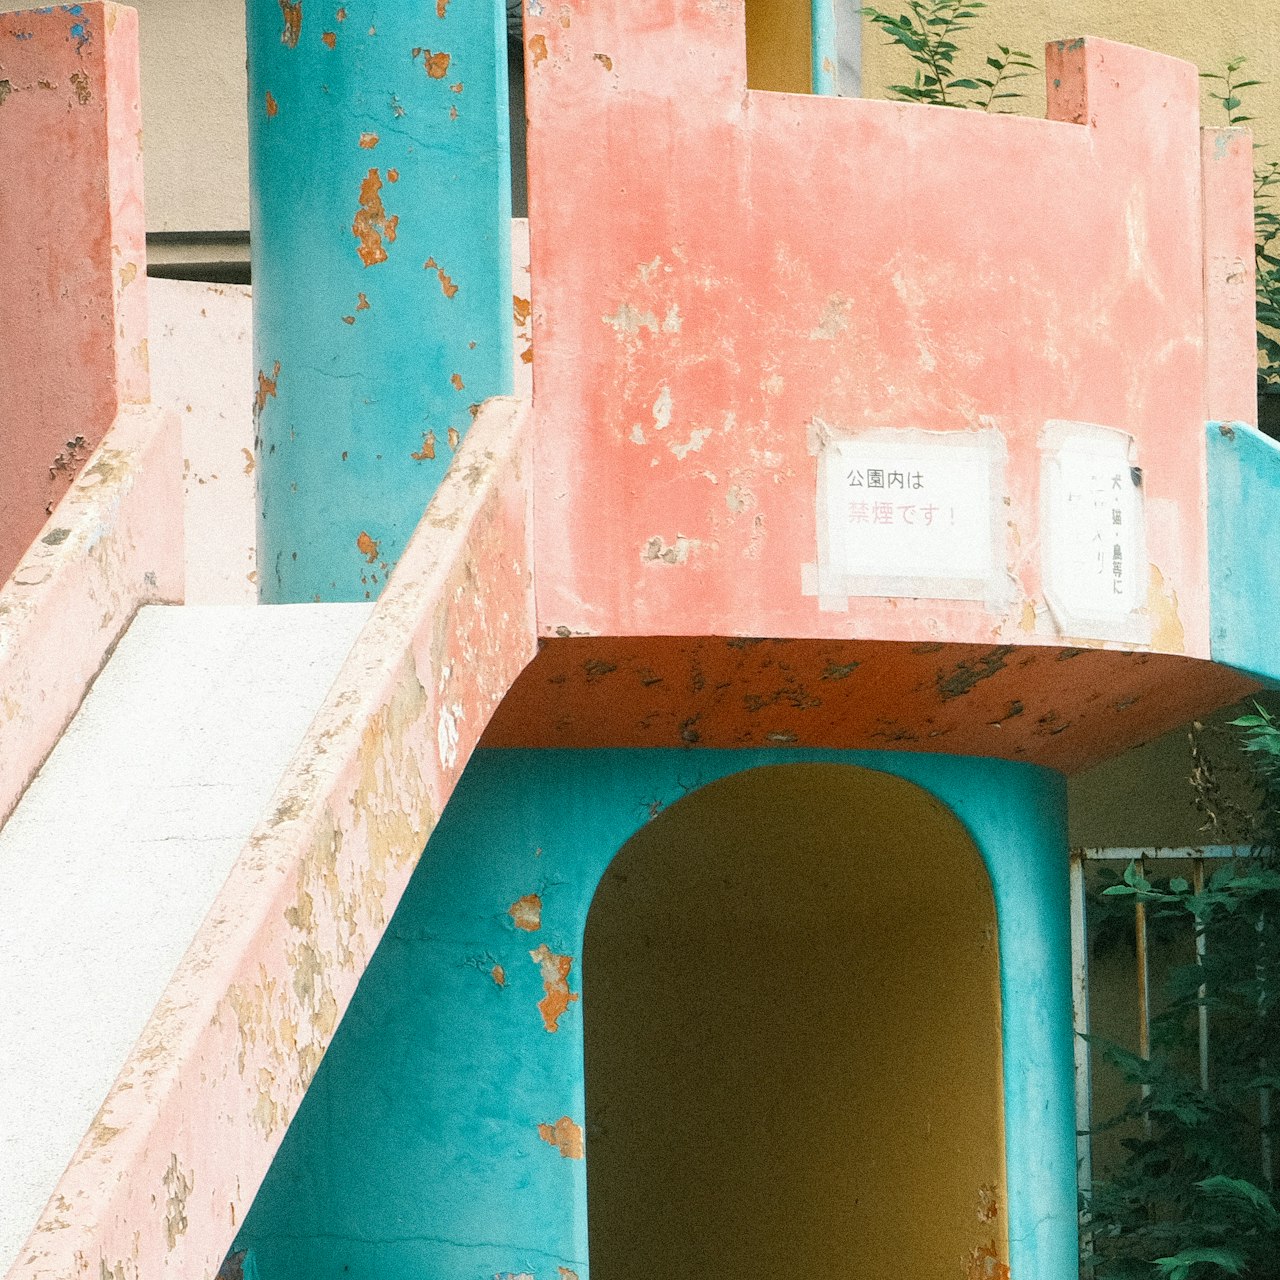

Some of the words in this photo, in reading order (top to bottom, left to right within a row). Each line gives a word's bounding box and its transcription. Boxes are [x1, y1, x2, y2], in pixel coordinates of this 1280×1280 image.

[847, 469, 924, 489] 公園内は
[849, 500, 954, 526] 禁煙です！
